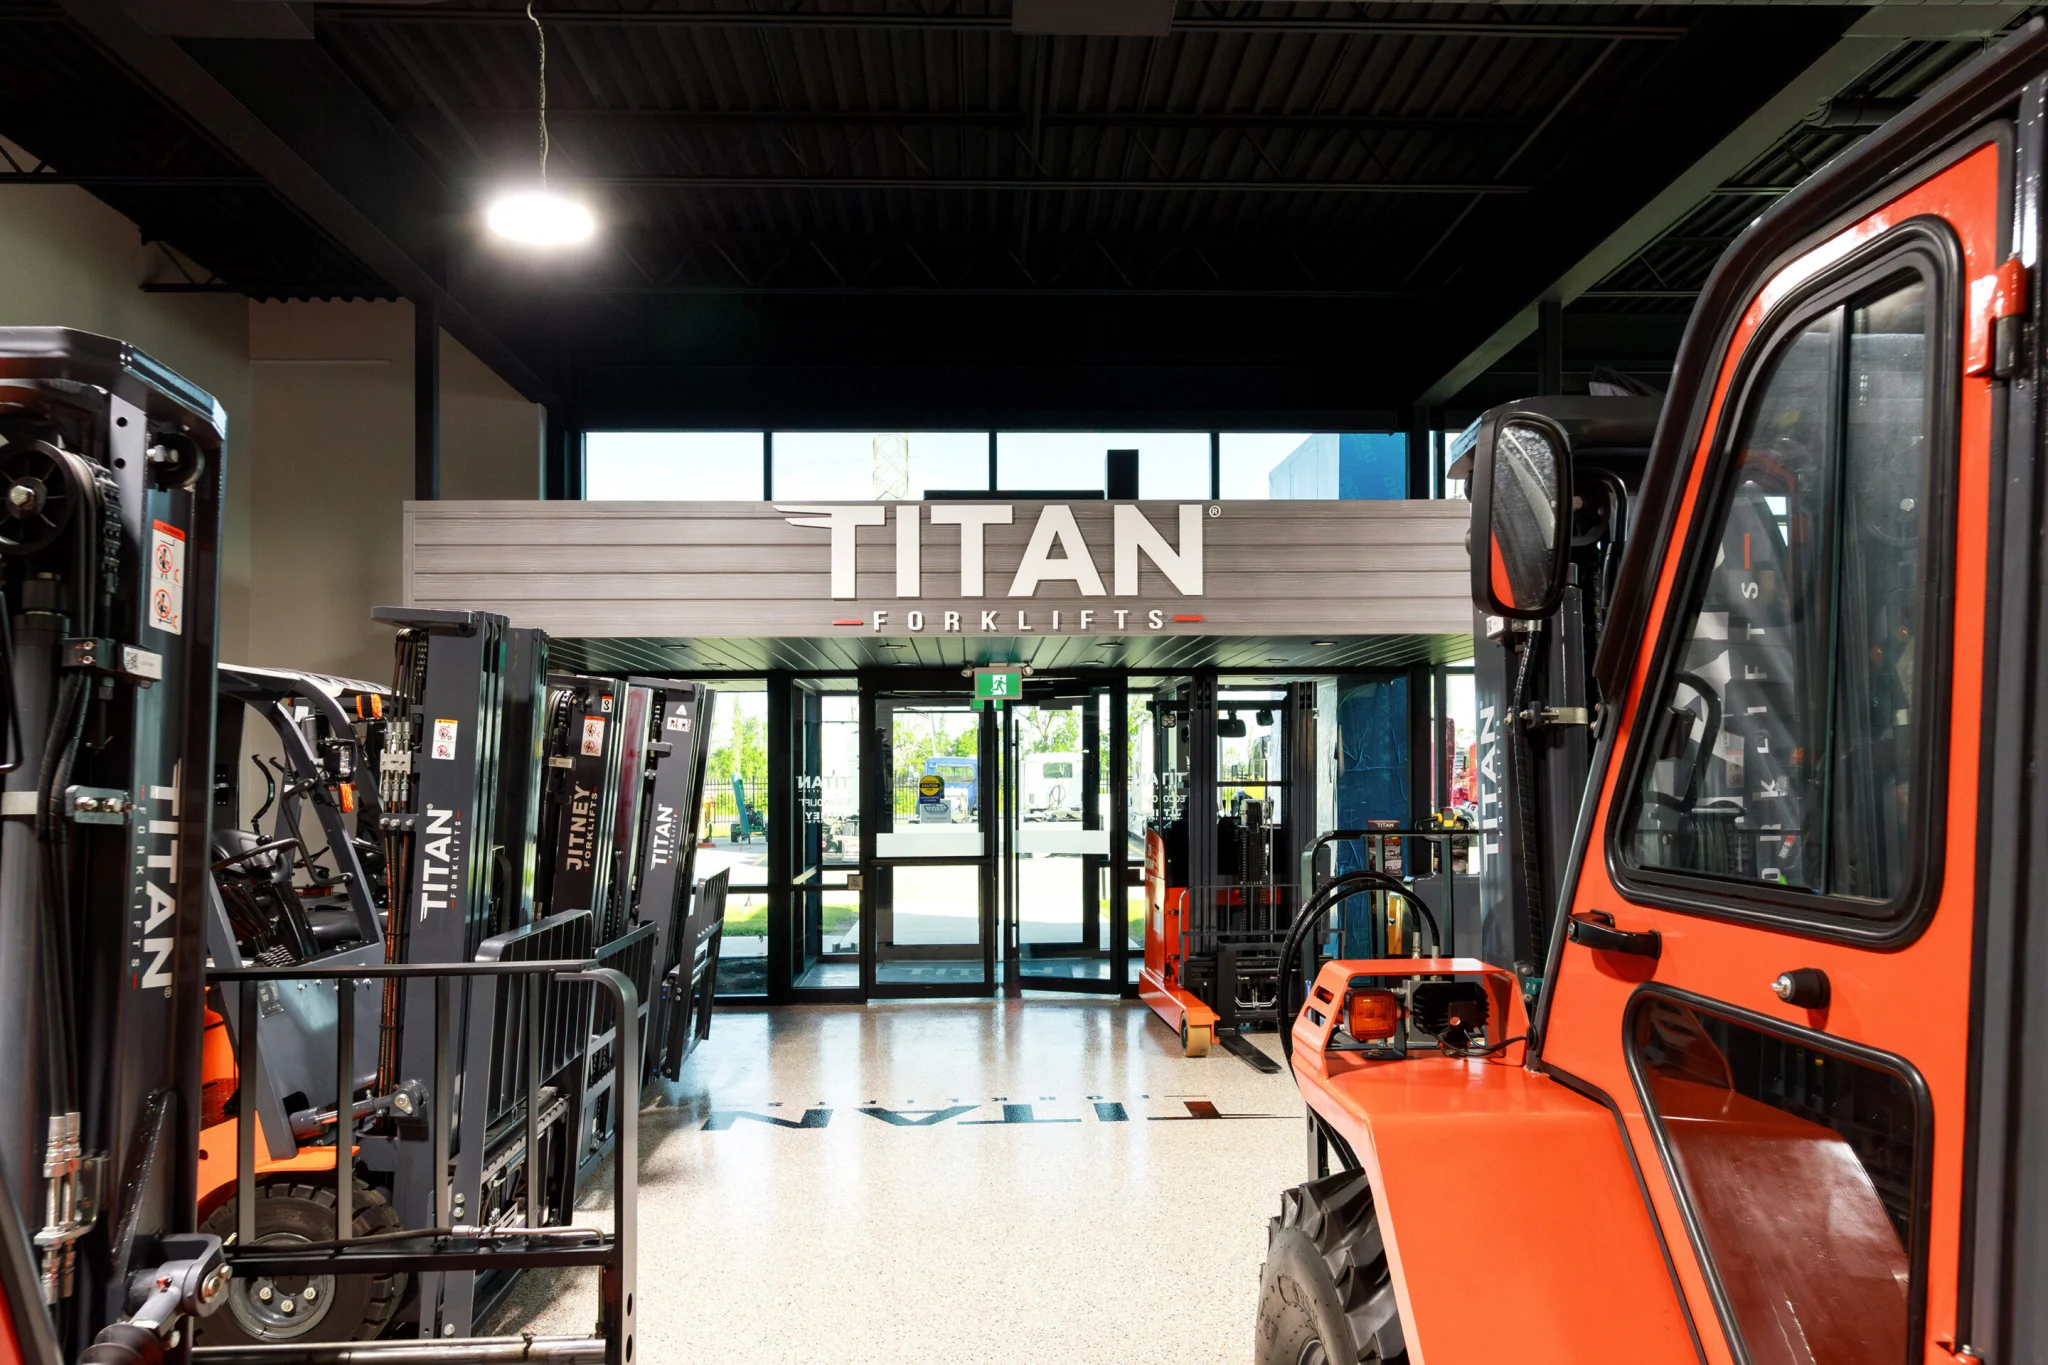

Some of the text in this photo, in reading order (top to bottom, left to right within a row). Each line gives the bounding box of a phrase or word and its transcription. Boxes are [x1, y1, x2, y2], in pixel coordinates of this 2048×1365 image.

[773, 504, 1204, 599] TITAN
[873, 609, 1165, 632] FORKLIFTS
[1740, 581, 1781, 881] ORKLIFTS
[566, 785, 590, 871] JITNEY
[583, 793, 598, 868] FORKLIFTS
[650, 806, 674, 871] TITAN
[1480, 705, 1499, 877] TITAN
[131, 806, 147, 967] FORKLIFTS
[142, 758, 181, 988] TITAN
[420, 809, 453, 922] TITAN
[450, 821, 461, 898] FORKLIFTS
